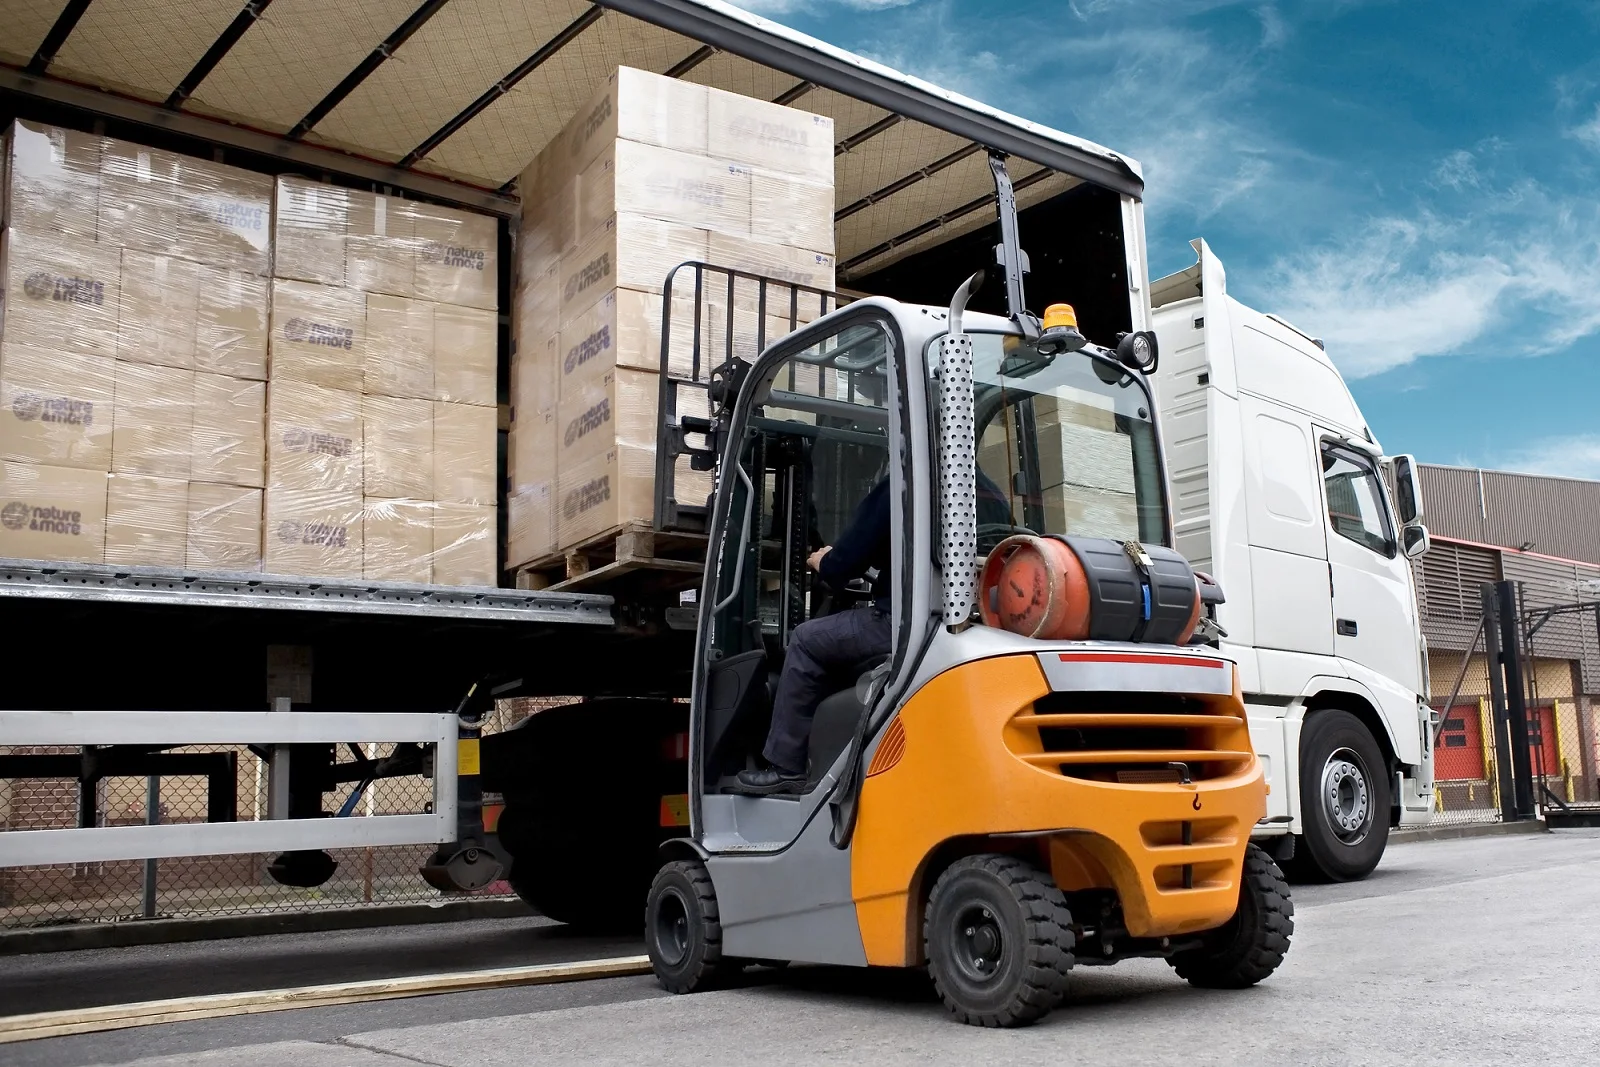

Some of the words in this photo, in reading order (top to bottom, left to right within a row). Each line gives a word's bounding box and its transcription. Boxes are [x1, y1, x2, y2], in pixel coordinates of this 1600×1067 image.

[443, 256, 484, 271] &more
[447, 246, 484, 260] nature
[580, 251, 608, 280] nature
[578, 335, 610, 366] &more
[580, 324, 608, 353] nature
[578, 408, 610, 439] &more
[580, 397, 608, 426] nature
[29, 518, 81, 536] &more
[33, 505, 81, 523] nature
